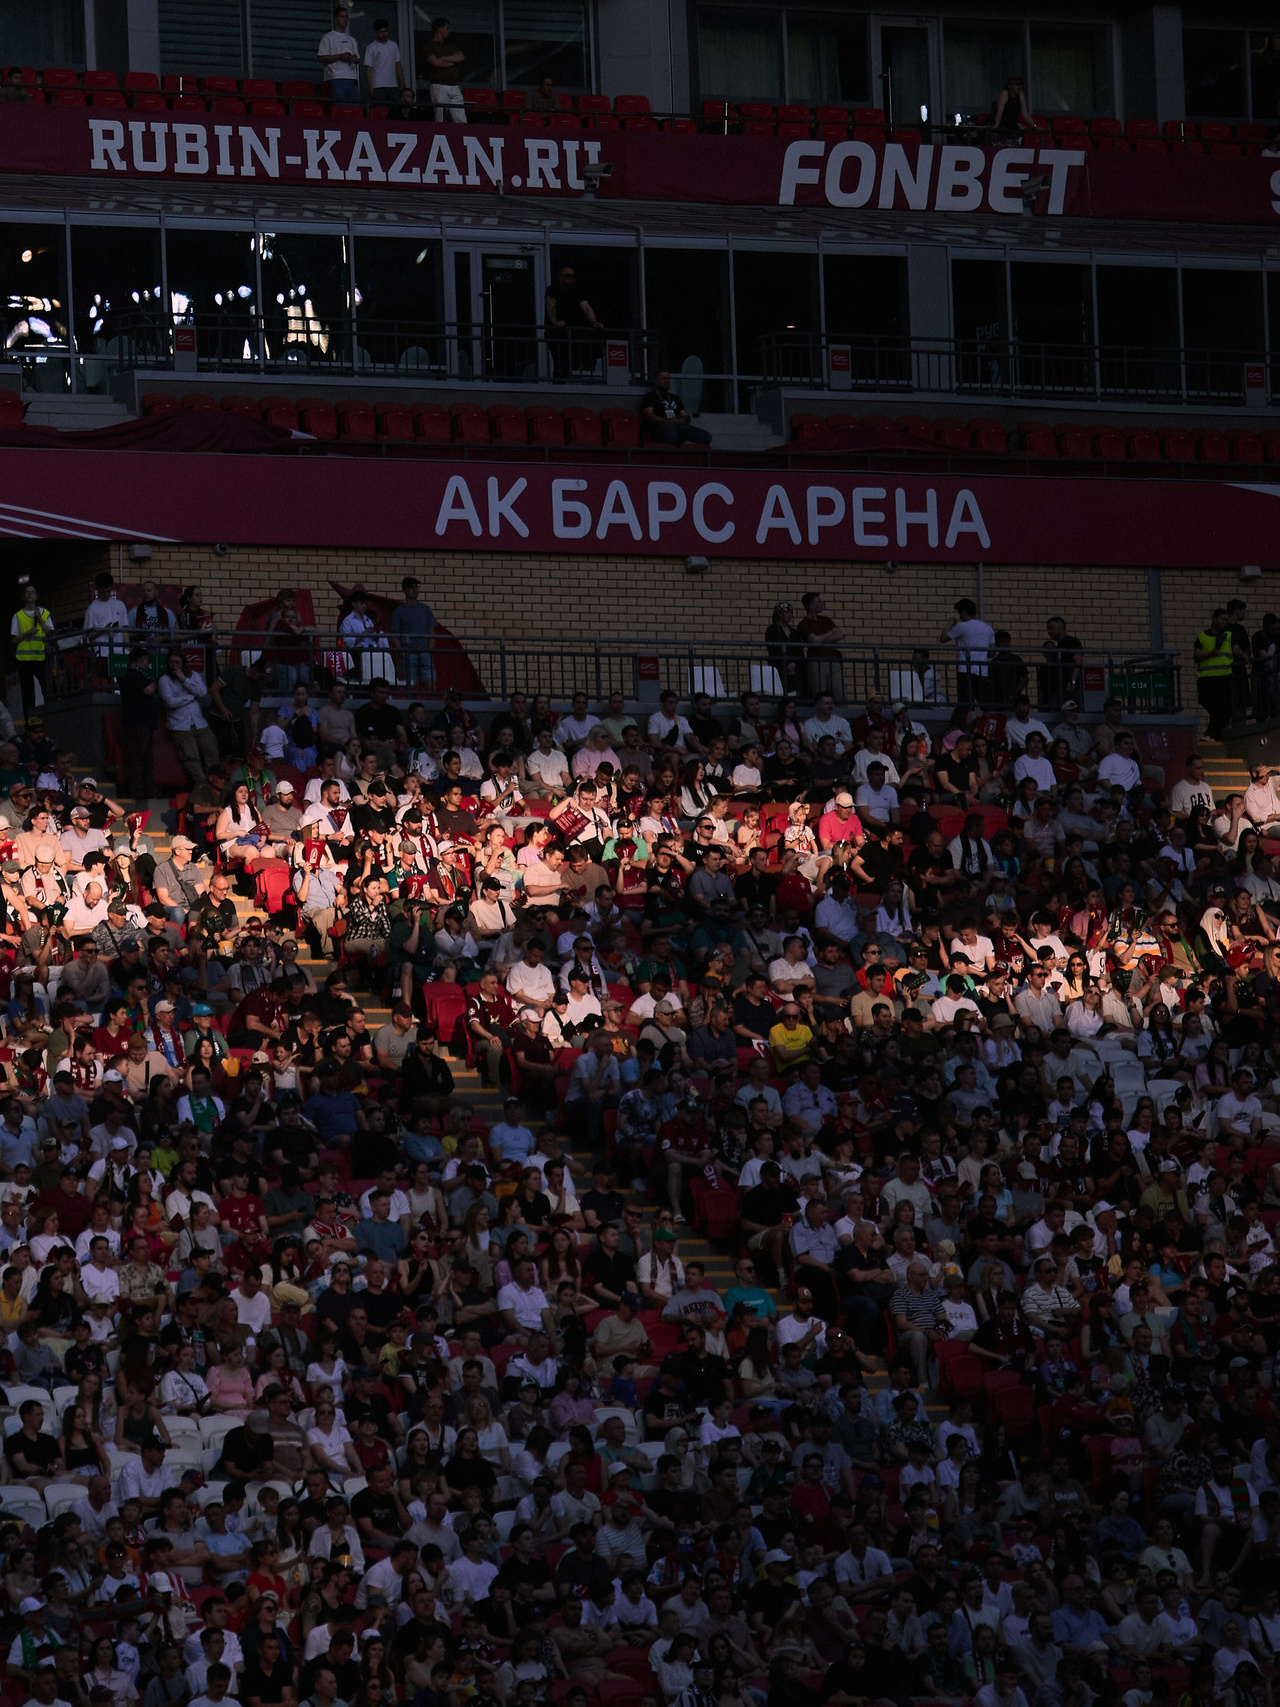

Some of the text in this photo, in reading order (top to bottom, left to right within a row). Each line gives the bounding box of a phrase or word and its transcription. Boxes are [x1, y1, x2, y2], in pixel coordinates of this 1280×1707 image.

[88, 118, 602, 191] RUBIN-KAZAN.RU
[778, 139, 1086, 215] FONBET
[434, 475, 991, 549] АК БАРС АРЕНА
